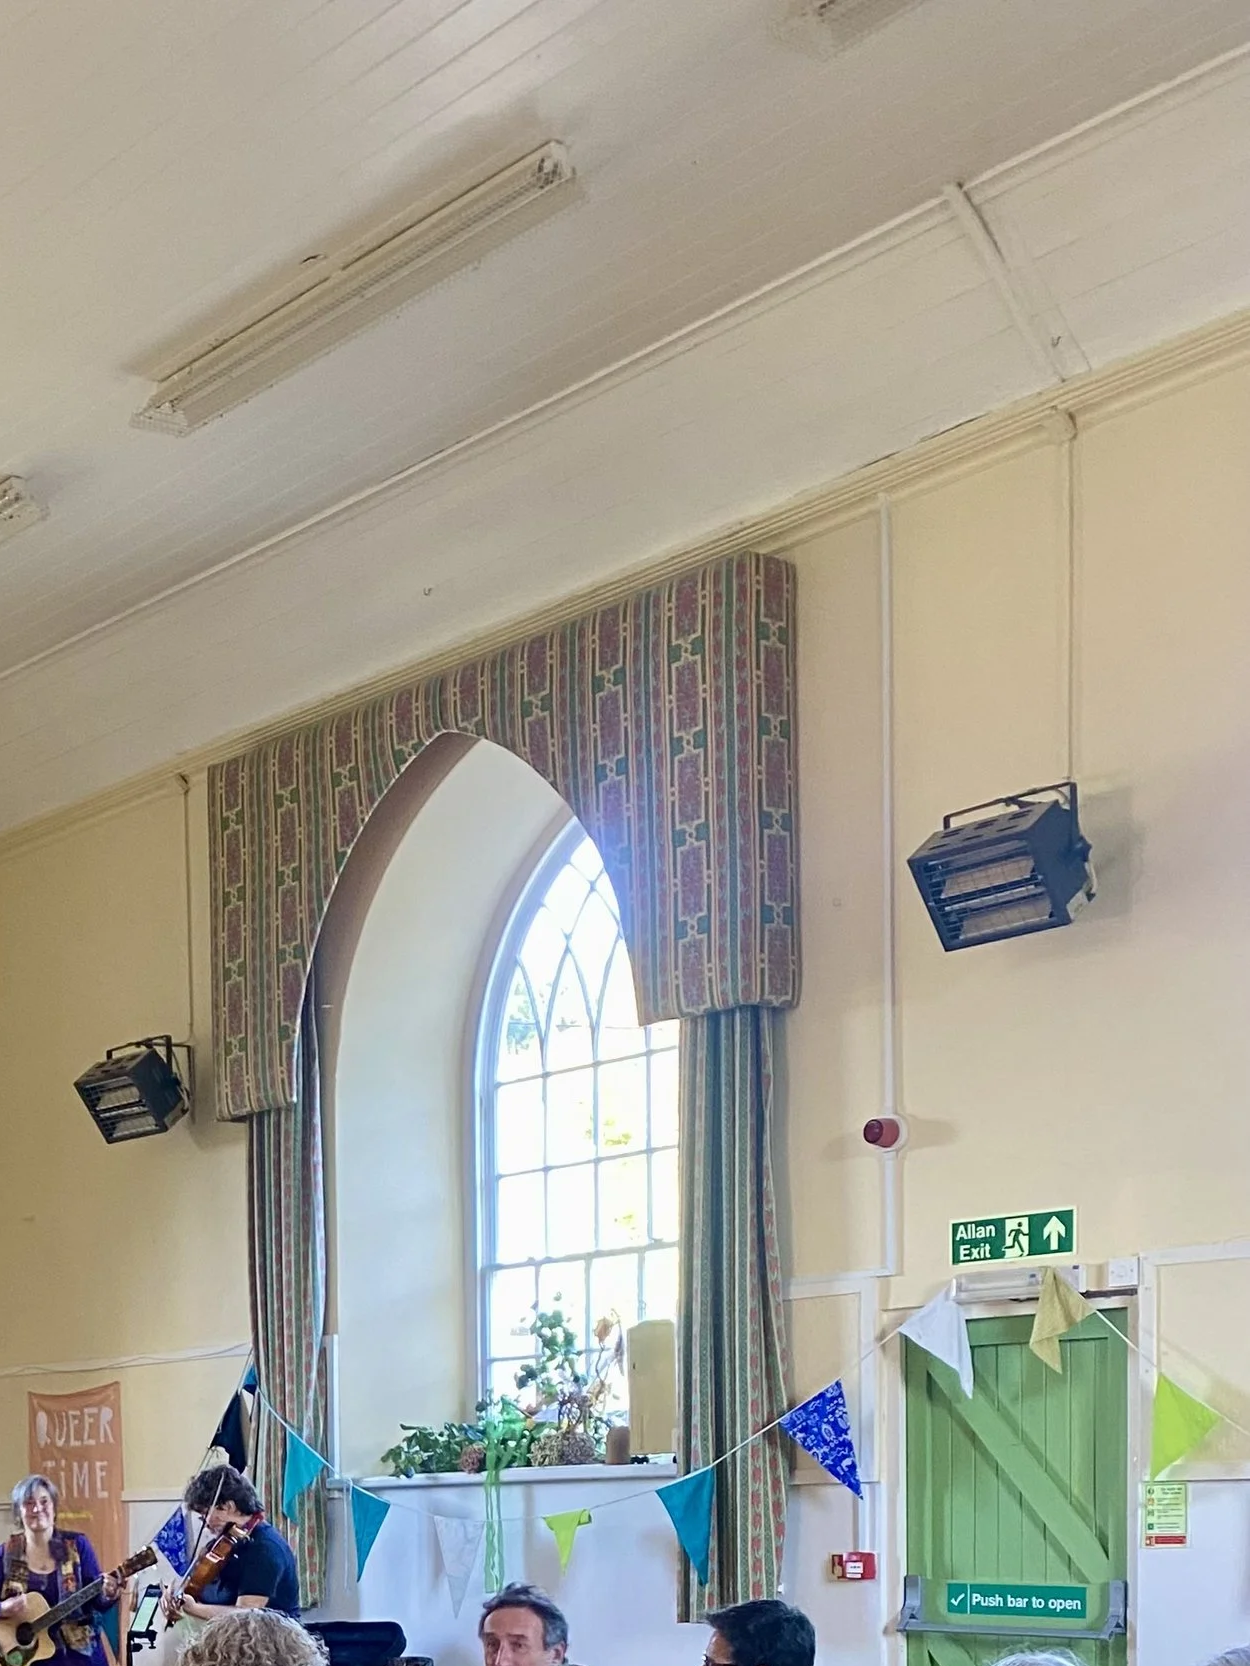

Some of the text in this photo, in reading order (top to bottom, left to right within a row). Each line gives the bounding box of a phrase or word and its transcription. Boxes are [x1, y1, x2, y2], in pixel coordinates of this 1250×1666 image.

[955, 1223, 996, 1241] Allan
[959, 1243, 991, 1261] Exit
[35, 1406, 115, 1448] QUEER
[971, 1593, 1082, 1613] Push bar to open
